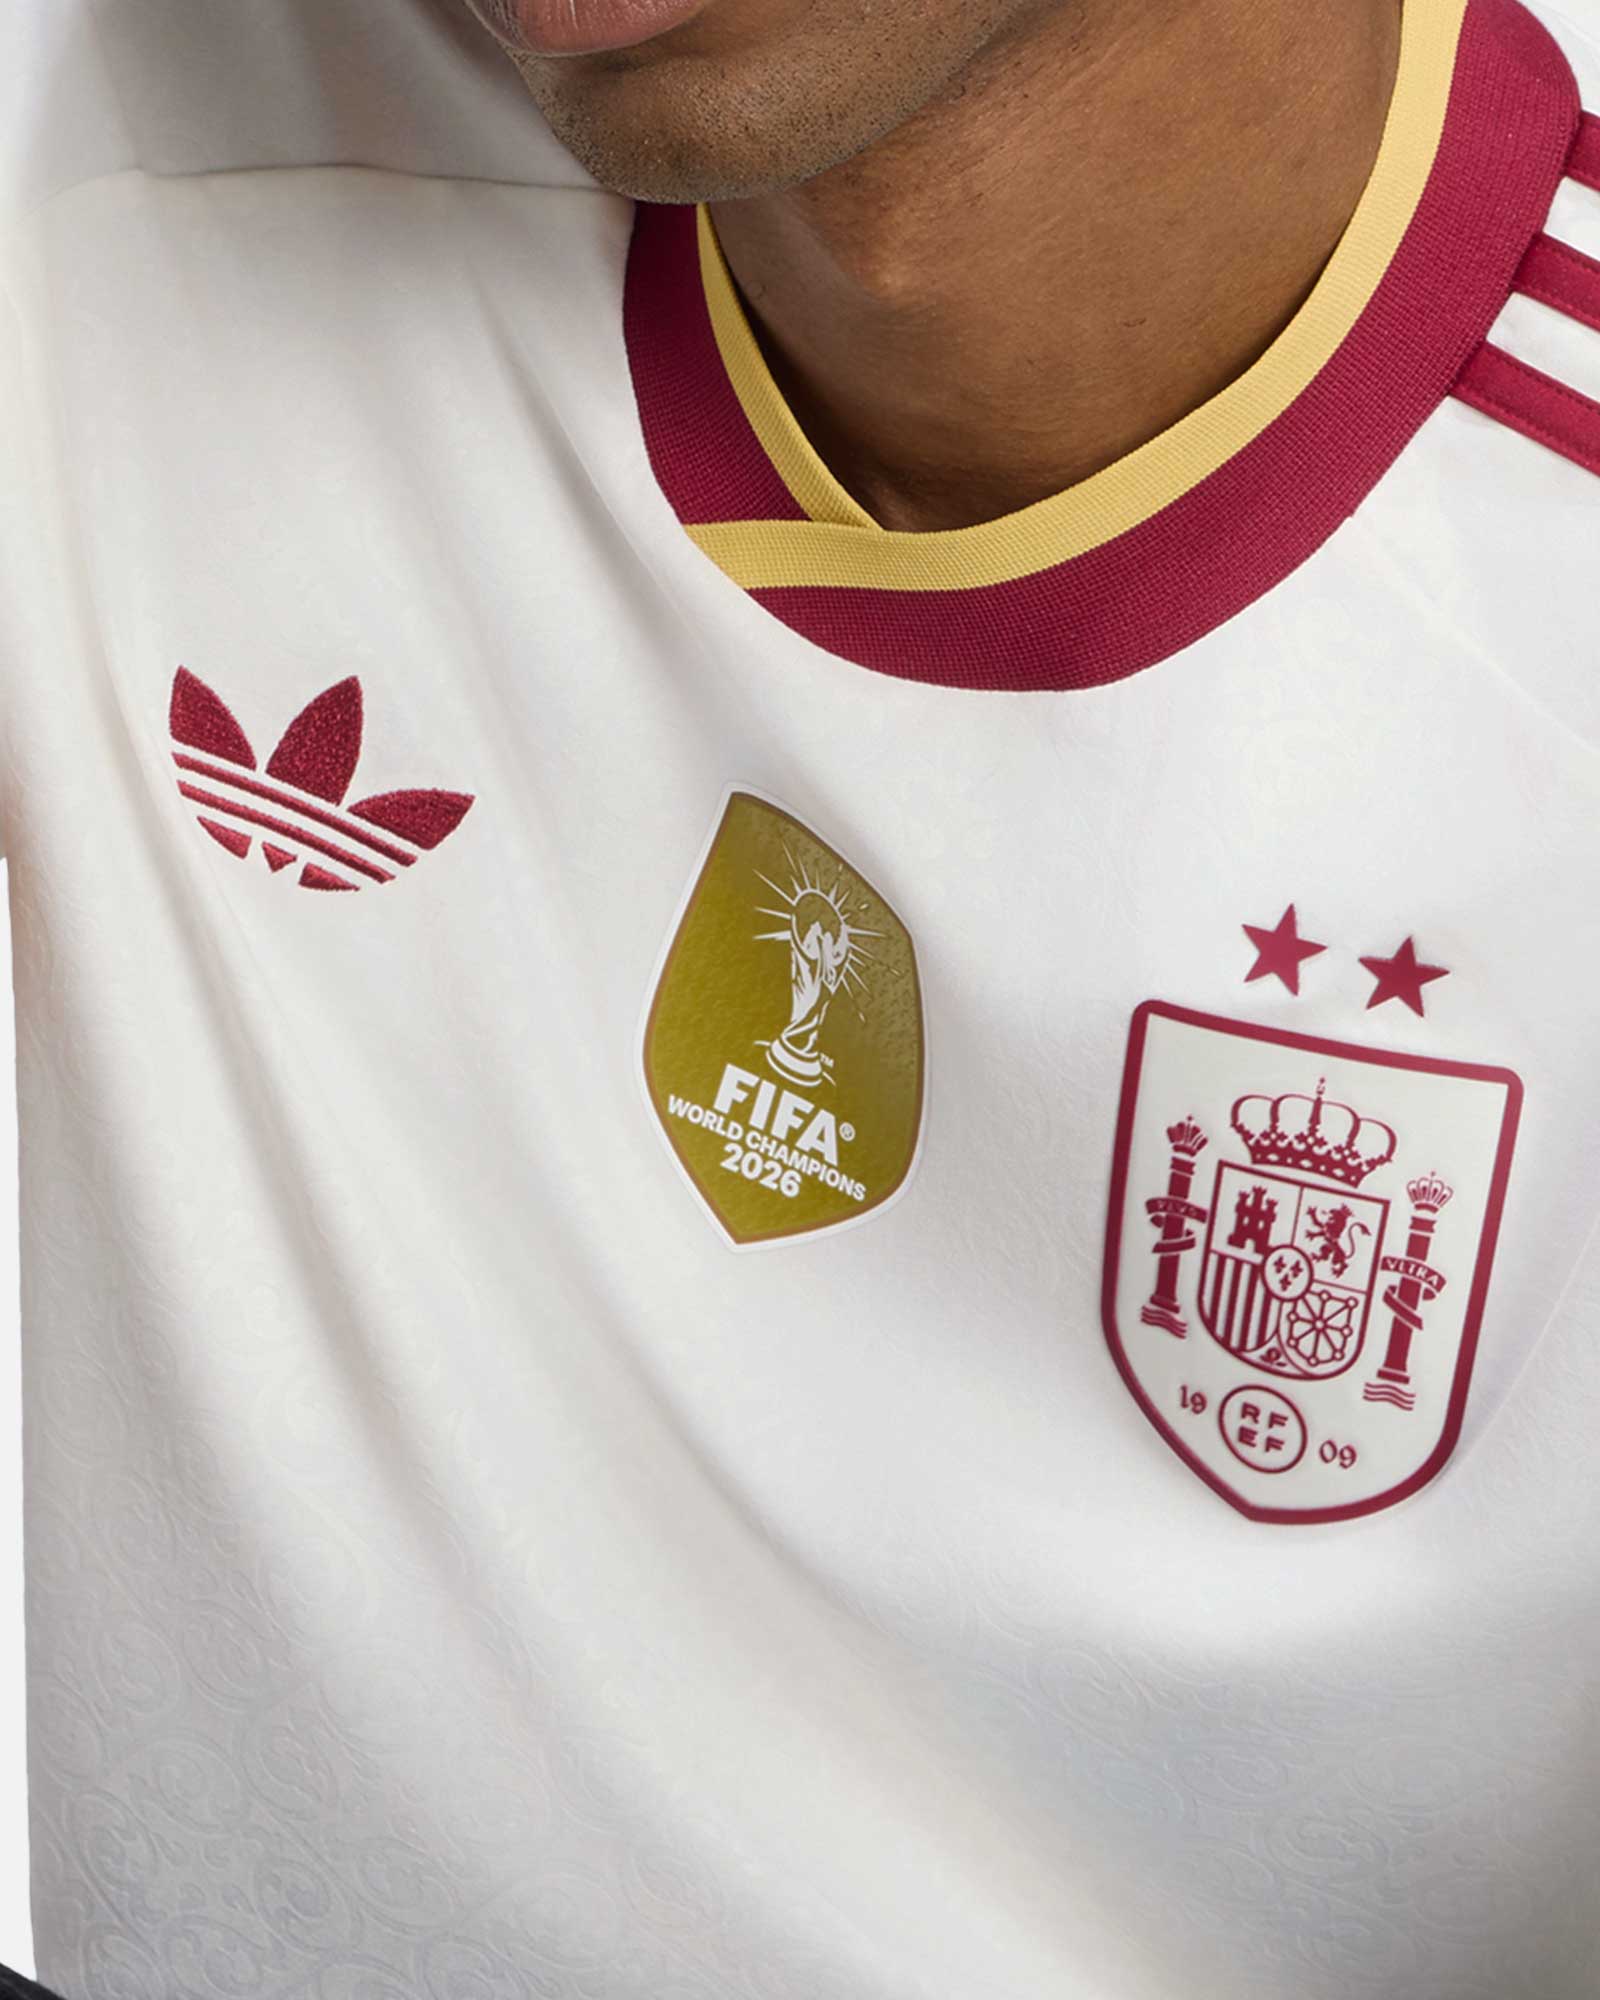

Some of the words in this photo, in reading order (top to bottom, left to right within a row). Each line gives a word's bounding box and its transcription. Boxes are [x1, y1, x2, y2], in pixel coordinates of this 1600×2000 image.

[668, 1094, 743, 1141] WORLD
[745, 1131, 866, 1201] CHAMPIONS
[720, 1143, 802, 1197] 2026
[1179, 1384, 1207, 1414] 19
[1319, 1440, 1357, 1469] 09
